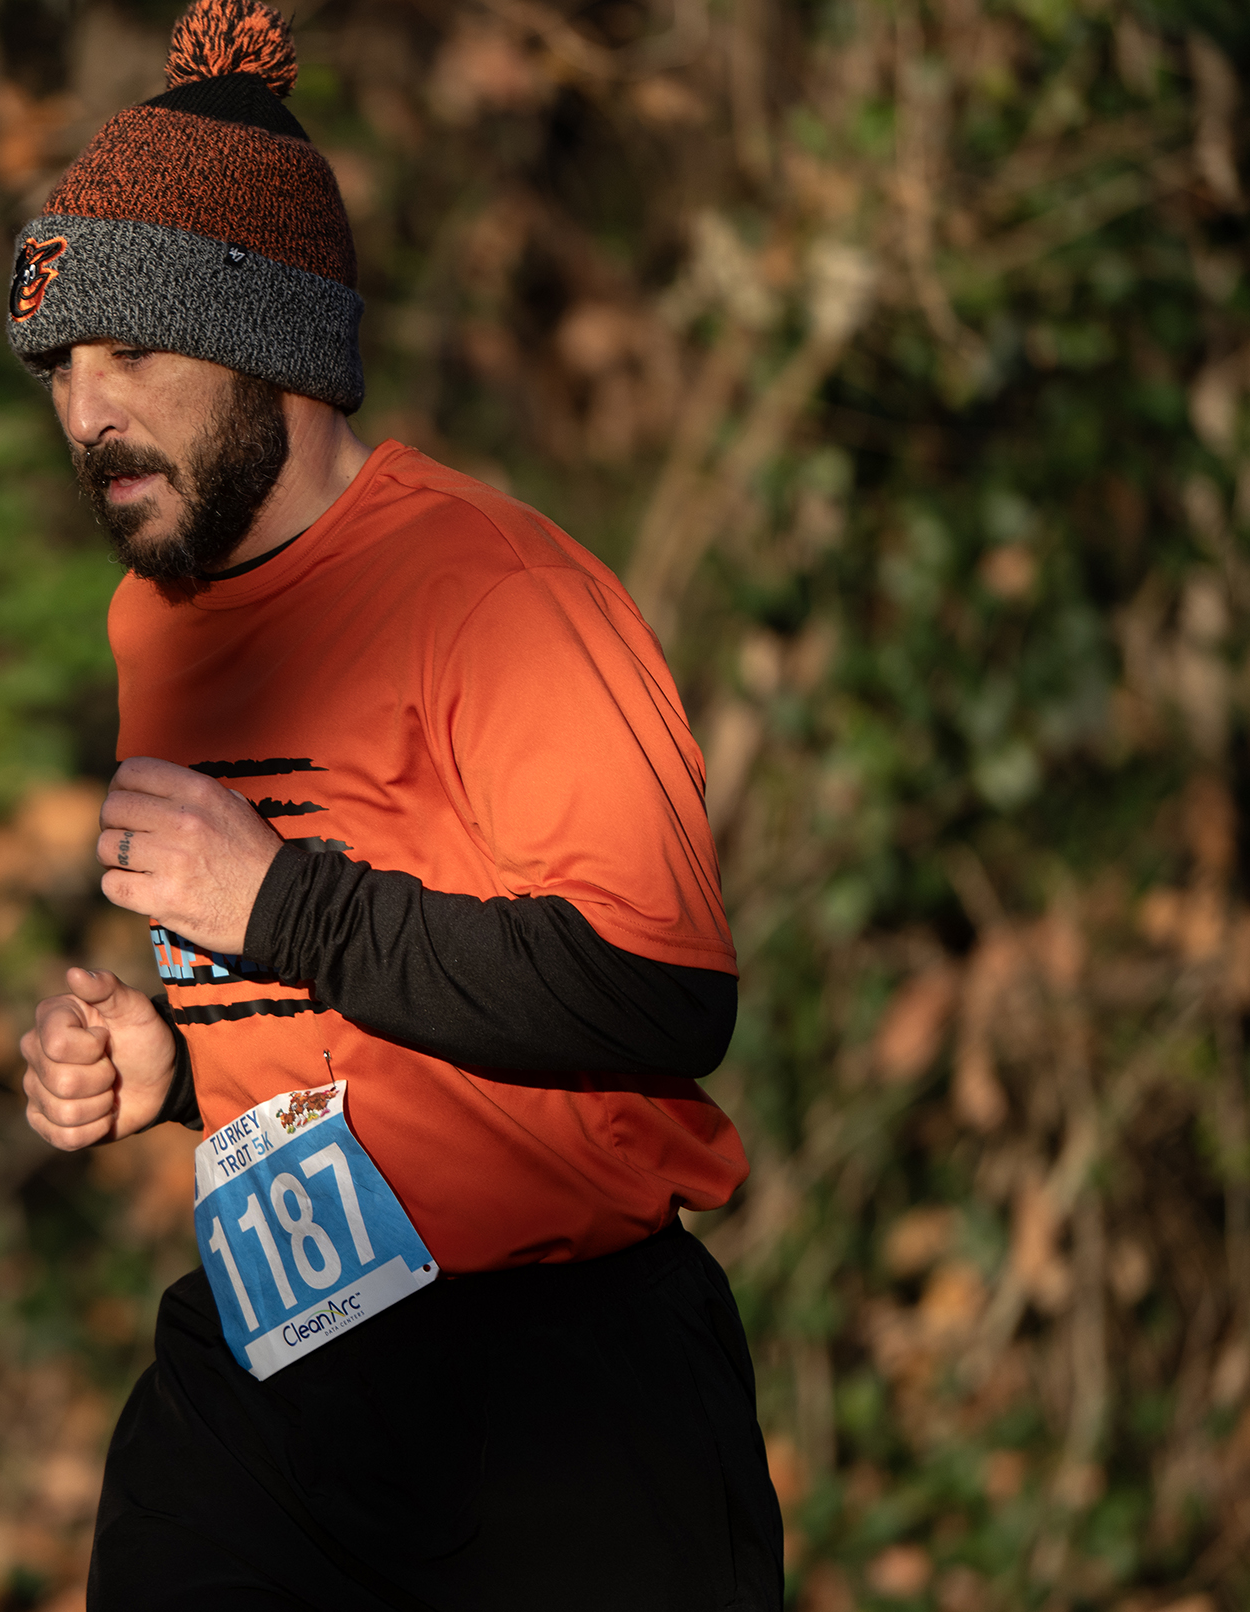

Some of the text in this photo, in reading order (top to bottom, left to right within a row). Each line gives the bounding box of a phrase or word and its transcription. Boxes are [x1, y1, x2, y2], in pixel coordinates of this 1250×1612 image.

[209, 1110, 261, 1155] TURKEY
[217, 1131, 274, 1177] TROT 5K
[208, 1142, 376, 1332] 1187
[324, 1310, 365, 1337] DATA CENTERS
